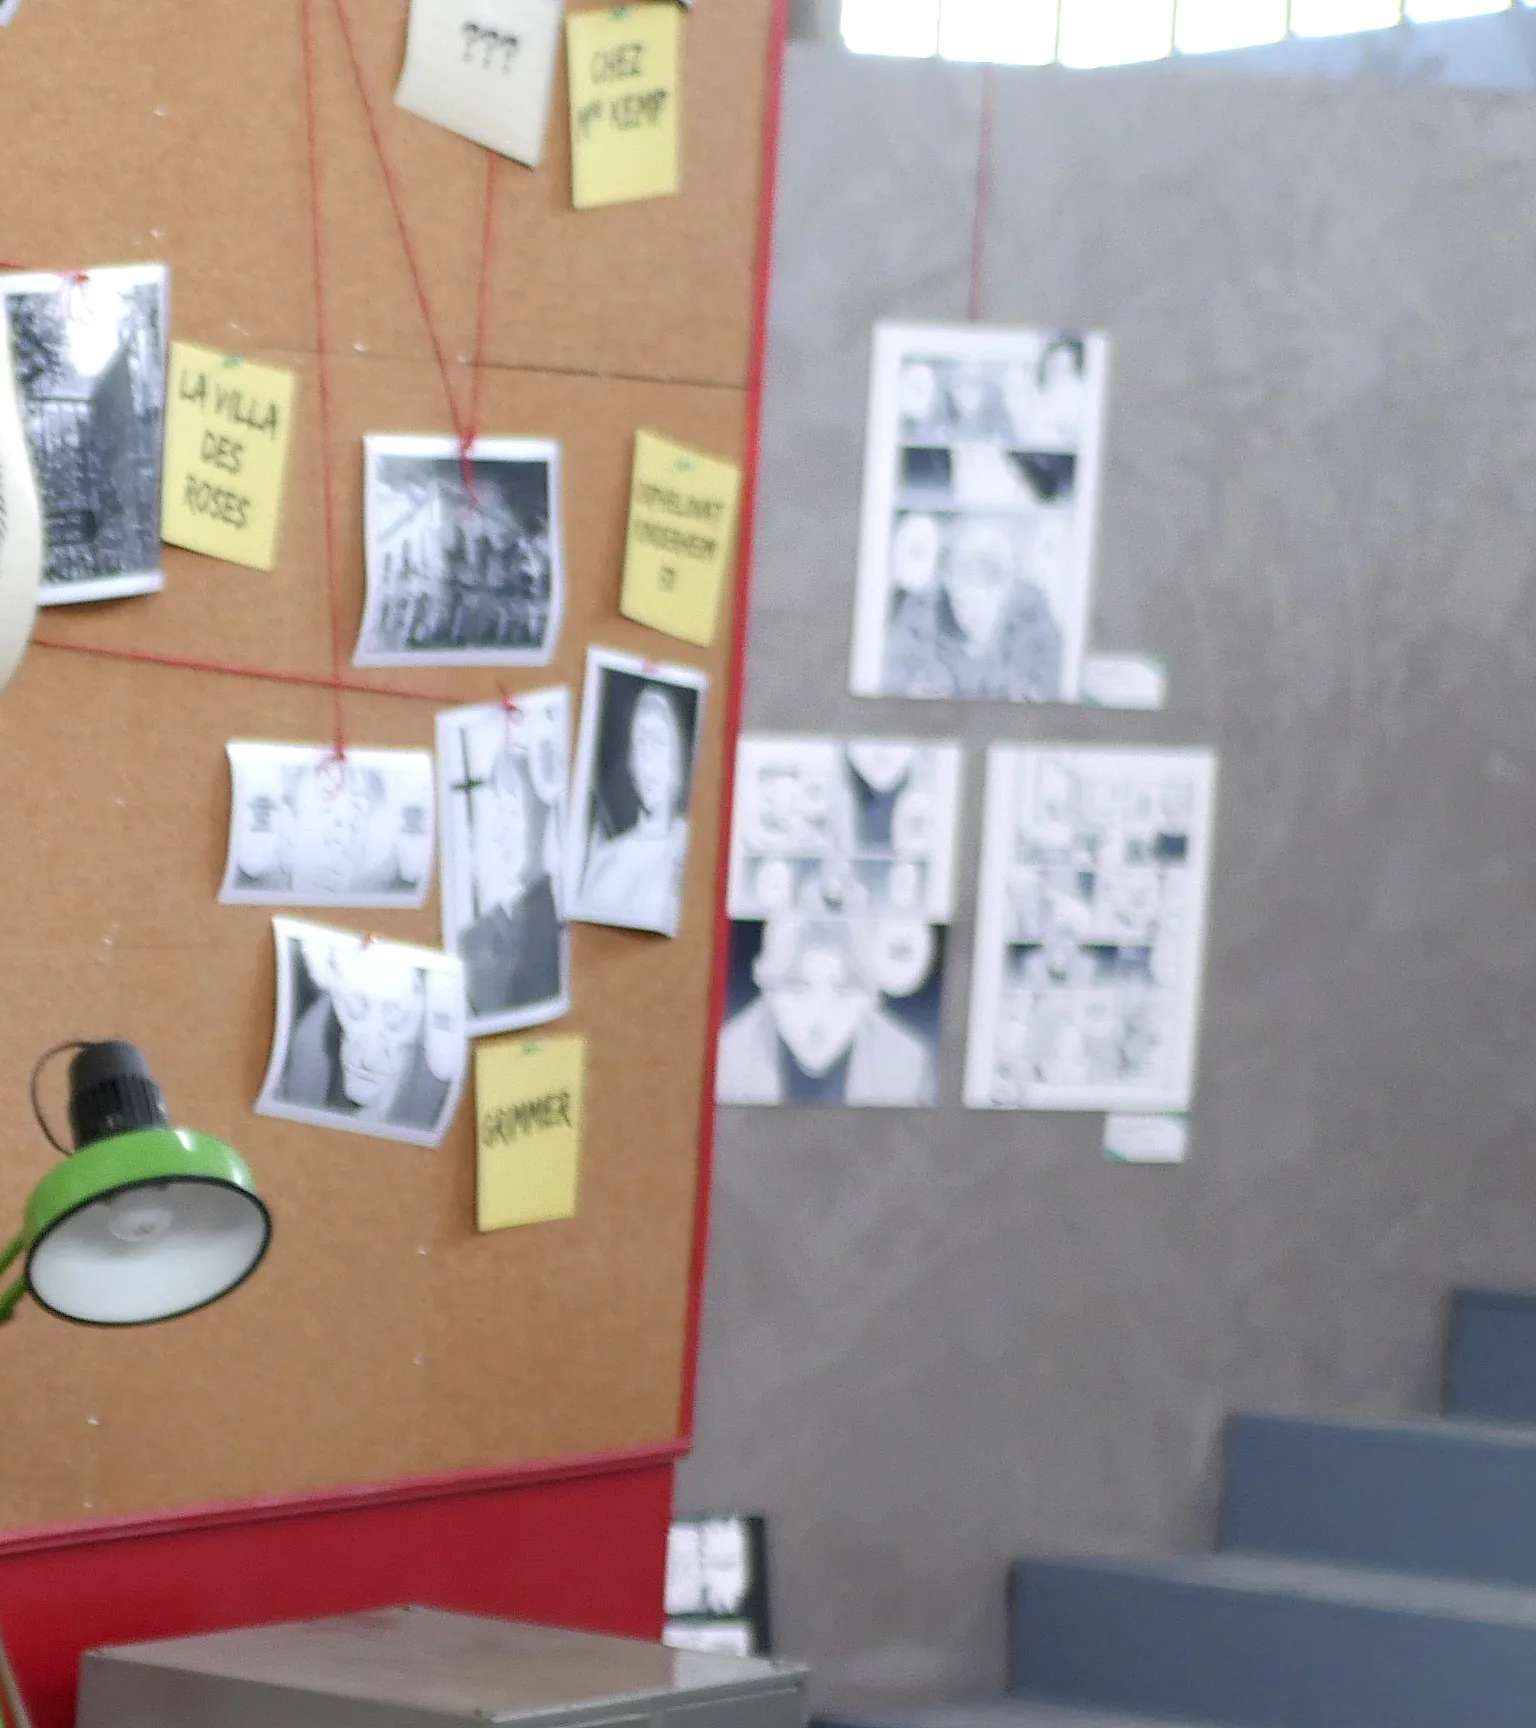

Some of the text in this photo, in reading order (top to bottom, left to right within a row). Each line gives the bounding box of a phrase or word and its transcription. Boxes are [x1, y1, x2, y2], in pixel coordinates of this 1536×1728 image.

[179, 367, 277, 443] LA VILLA
[200, 428, 245, 486] DES
[183, 472, 252, 531] ROSES
[483, 1091, 573, 1149] GRIMMER
